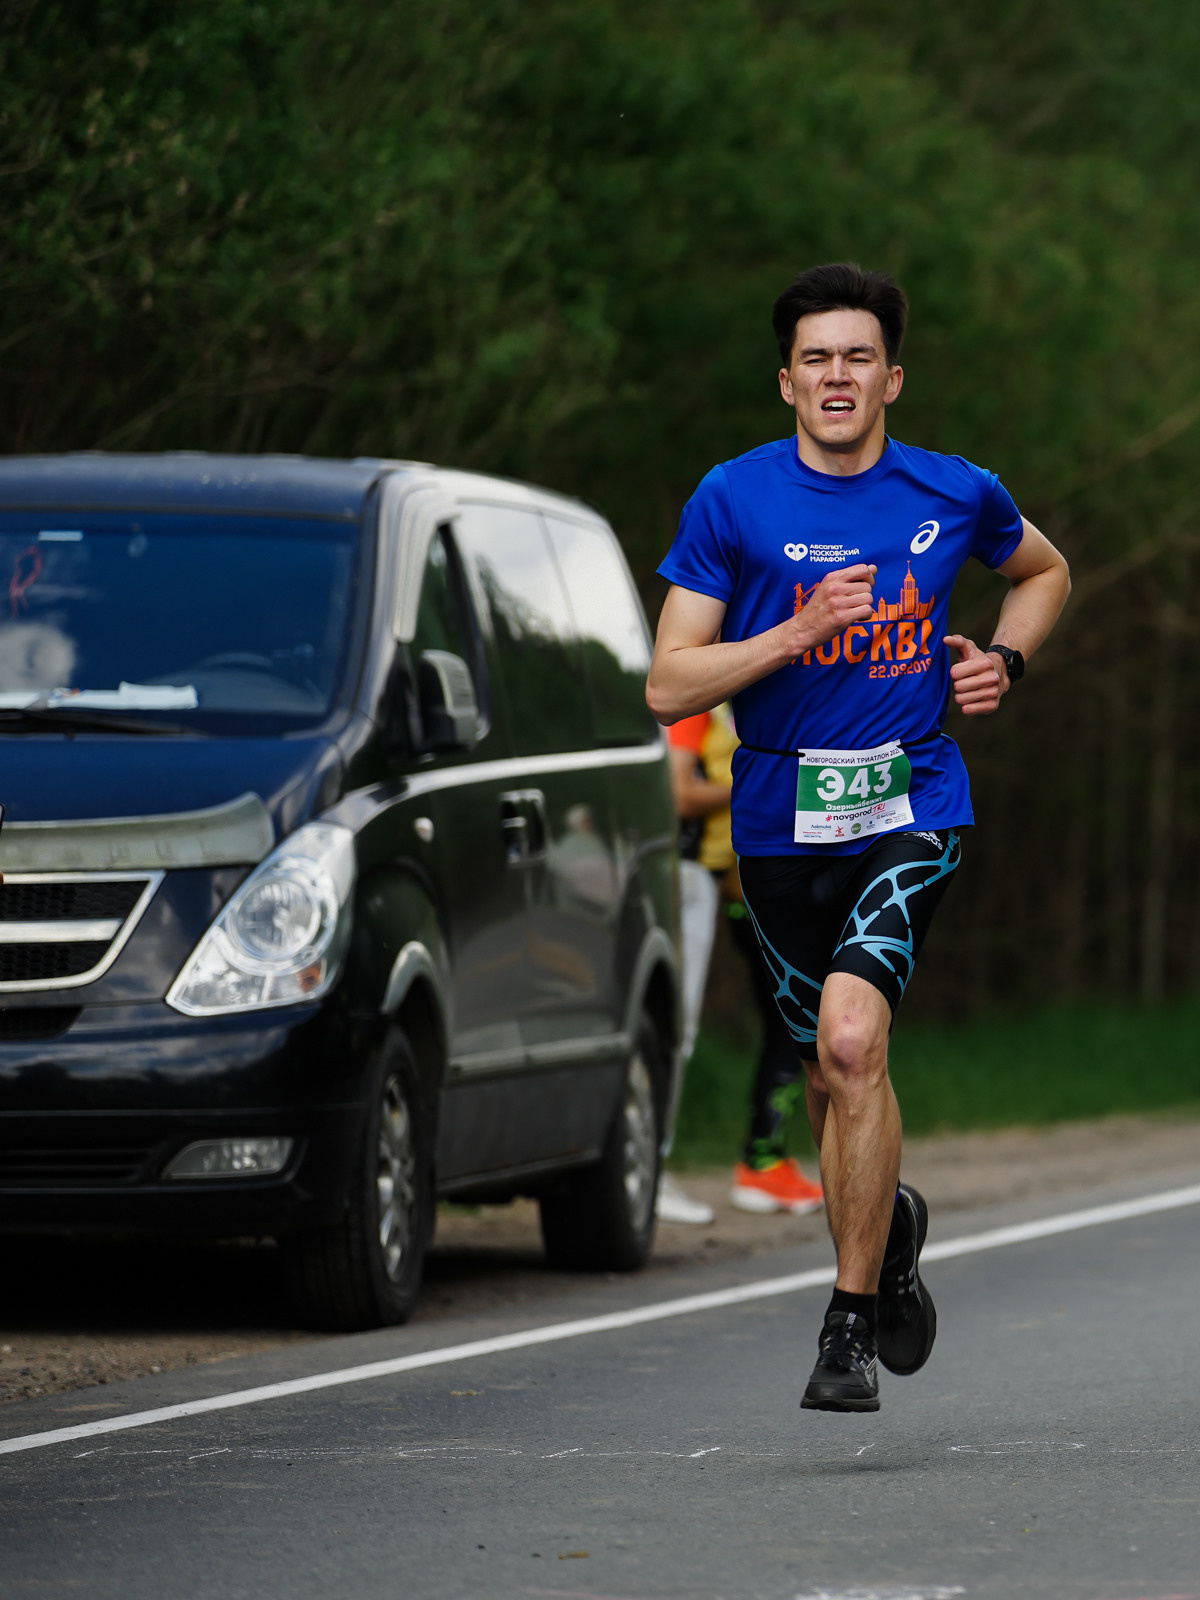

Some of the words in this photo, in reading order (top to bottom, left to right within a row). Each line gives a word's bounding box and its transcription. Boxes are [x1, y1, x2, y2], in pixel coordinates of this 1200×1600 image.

[809, 548, 860, 557] МОСКОВСКИЙ
[806, 757, 856, 765] НОВГОРОДСКИЙ
[857, 751, 890, 764] ТРИАТЛОН
[816, 761, 893, 802] Э43
